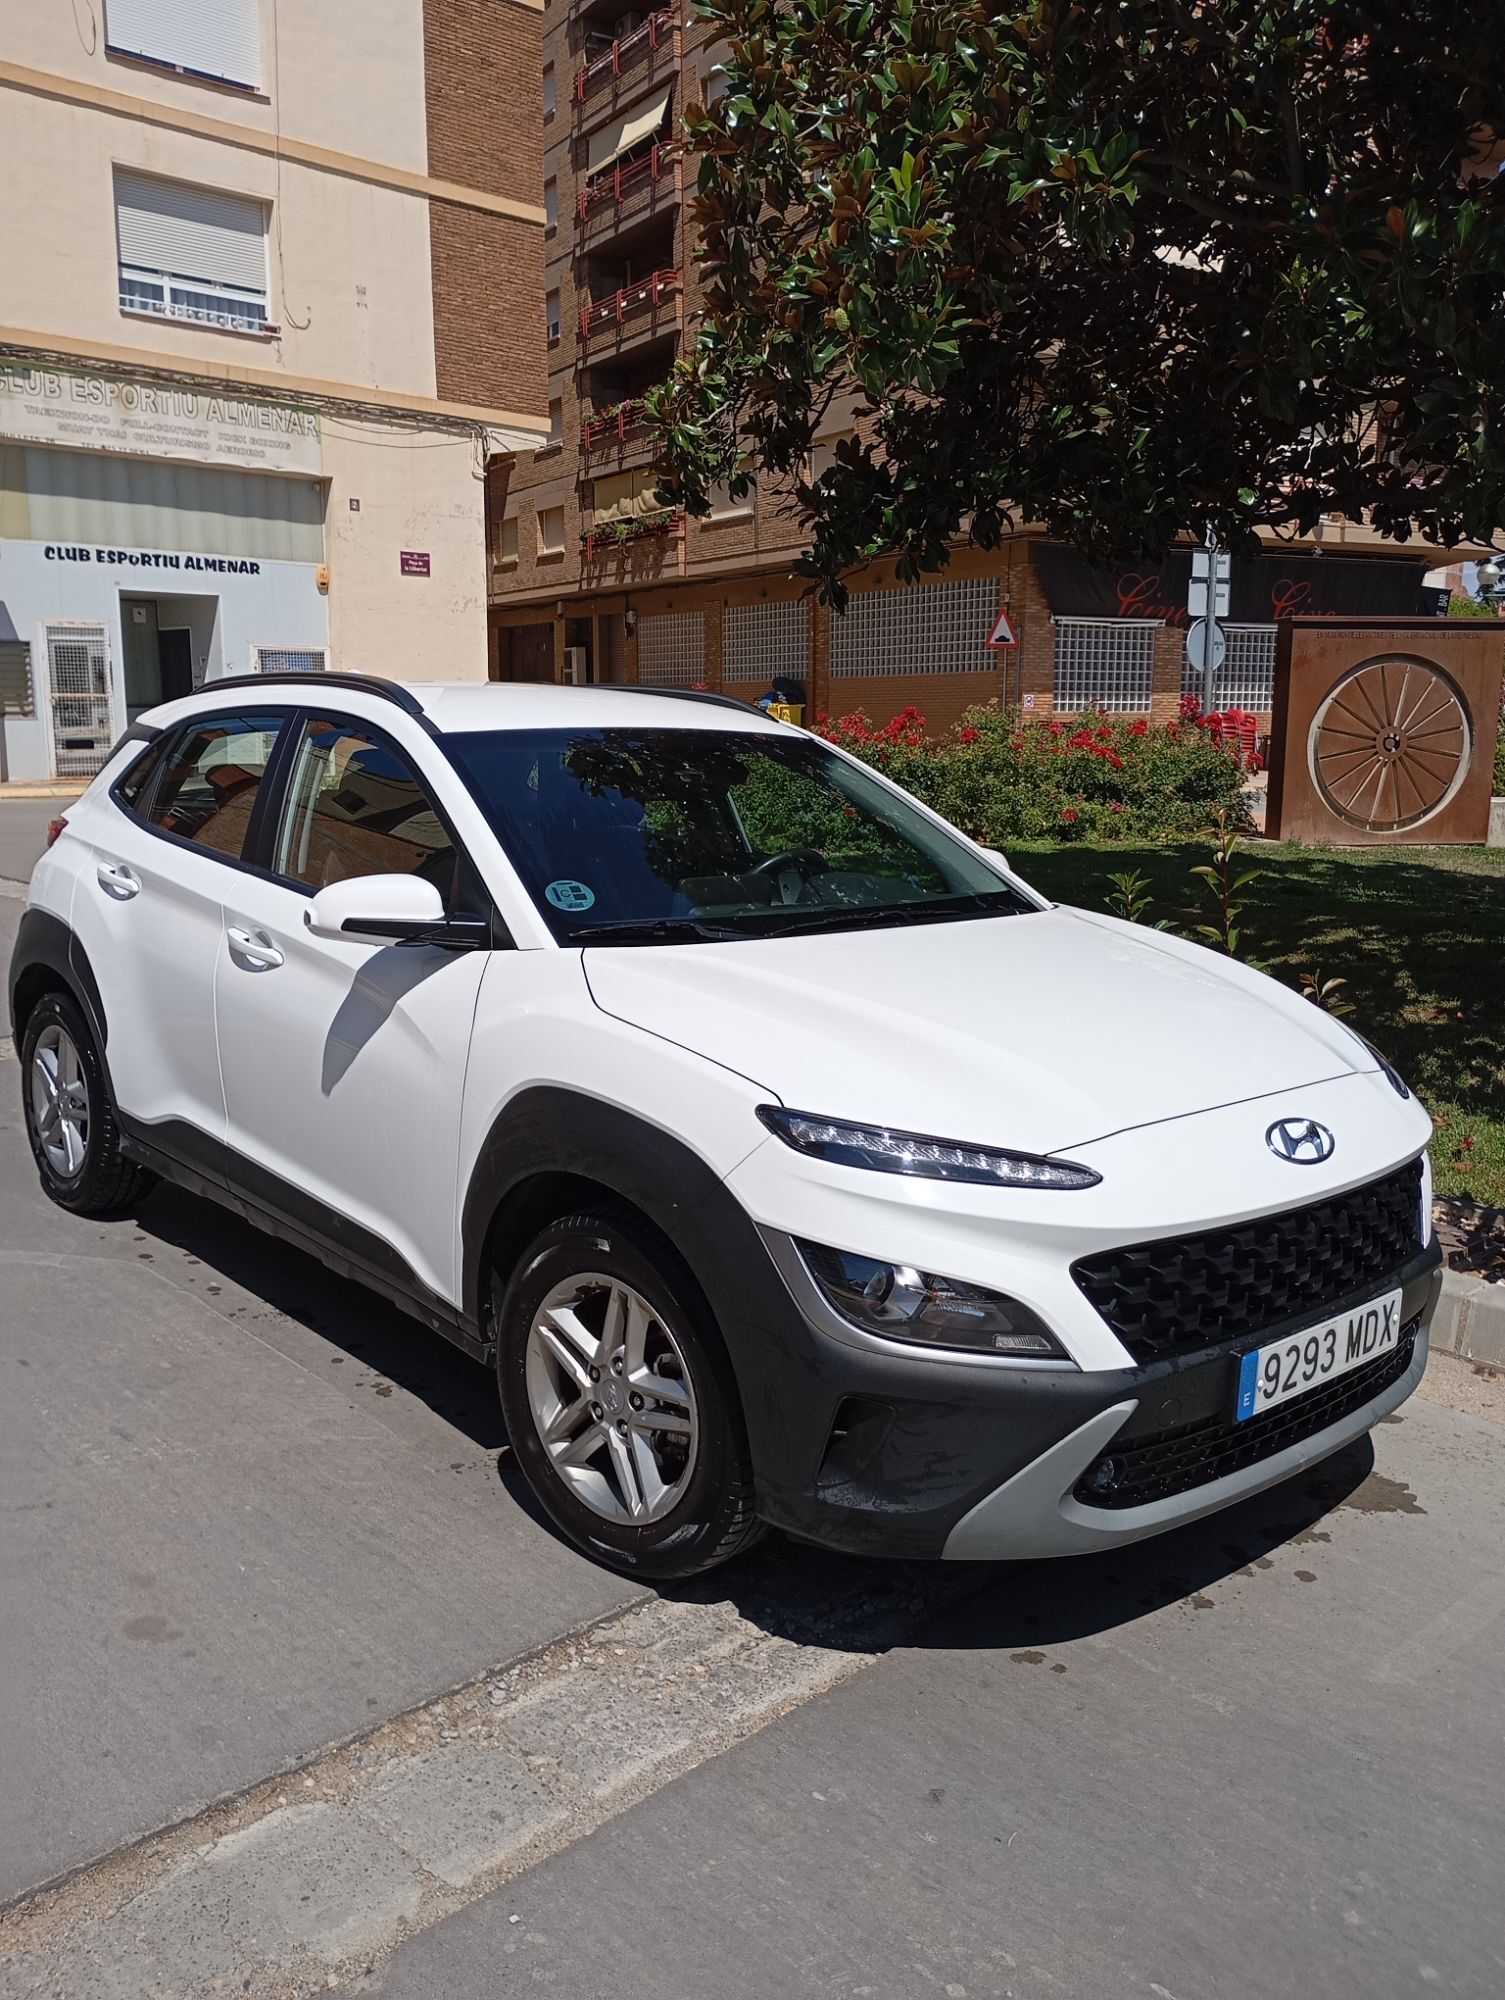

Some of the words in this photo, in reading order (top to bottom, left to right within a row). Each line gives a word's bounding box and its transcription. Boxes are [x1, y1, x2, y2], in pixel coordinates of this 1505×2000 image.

[70, 375, 199, 419] ESPORTIU
[206, 397, 318, 437] ALMENAR
[96, 427, 128, 440] THAI
[351, 501, 358, 509] 2
[44, 546, 91, 562] CLUB
[96, 549, 180, 569] ESPORTIU
[184, 556, 260, 575] ALMENAR
[1437, 594, 1449, 607] BAR
[1263, 1329, 1336, 1399] 9293
[1345, 1300, 1395, 1363] MDX
[1243, 1392, 1250, 1407] E
